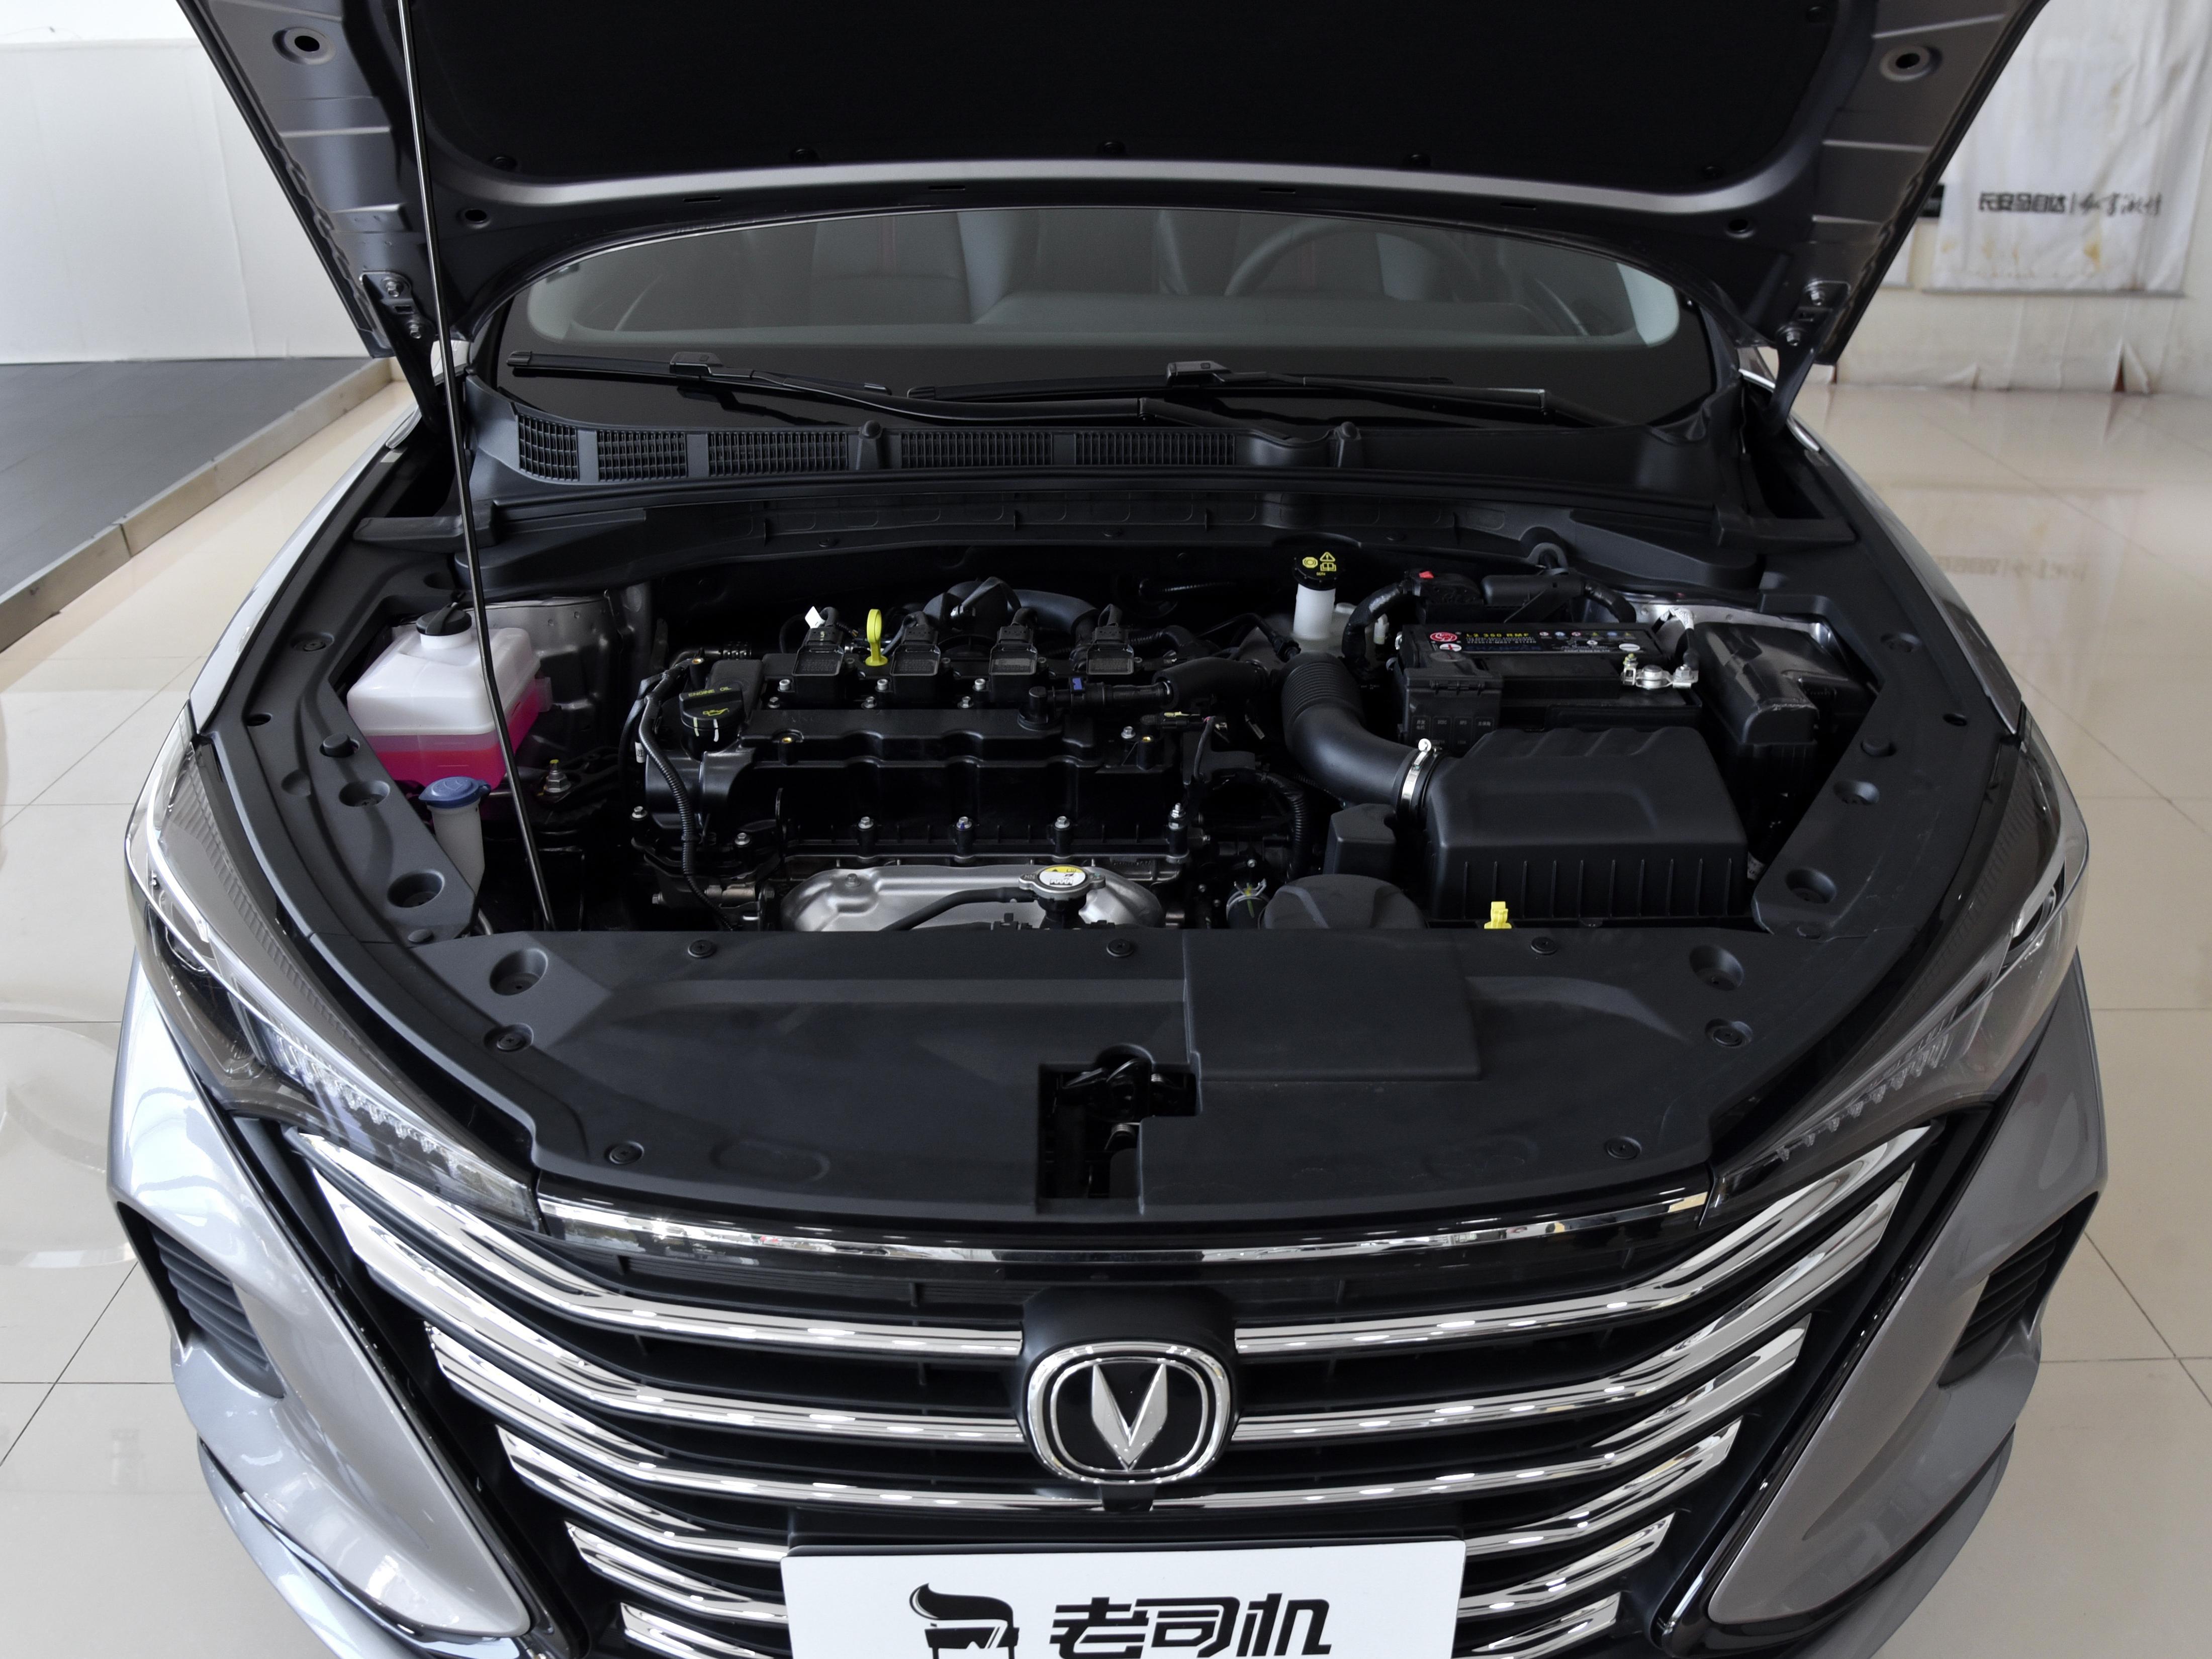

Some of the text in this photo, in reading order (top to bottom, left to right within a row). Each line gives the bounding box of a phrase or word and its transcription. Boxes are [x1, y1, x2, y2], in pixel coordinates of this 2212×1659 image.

[688, 689, 715, 697] ENGINE
[1049, 1593, 1332, 1659] 老司机
